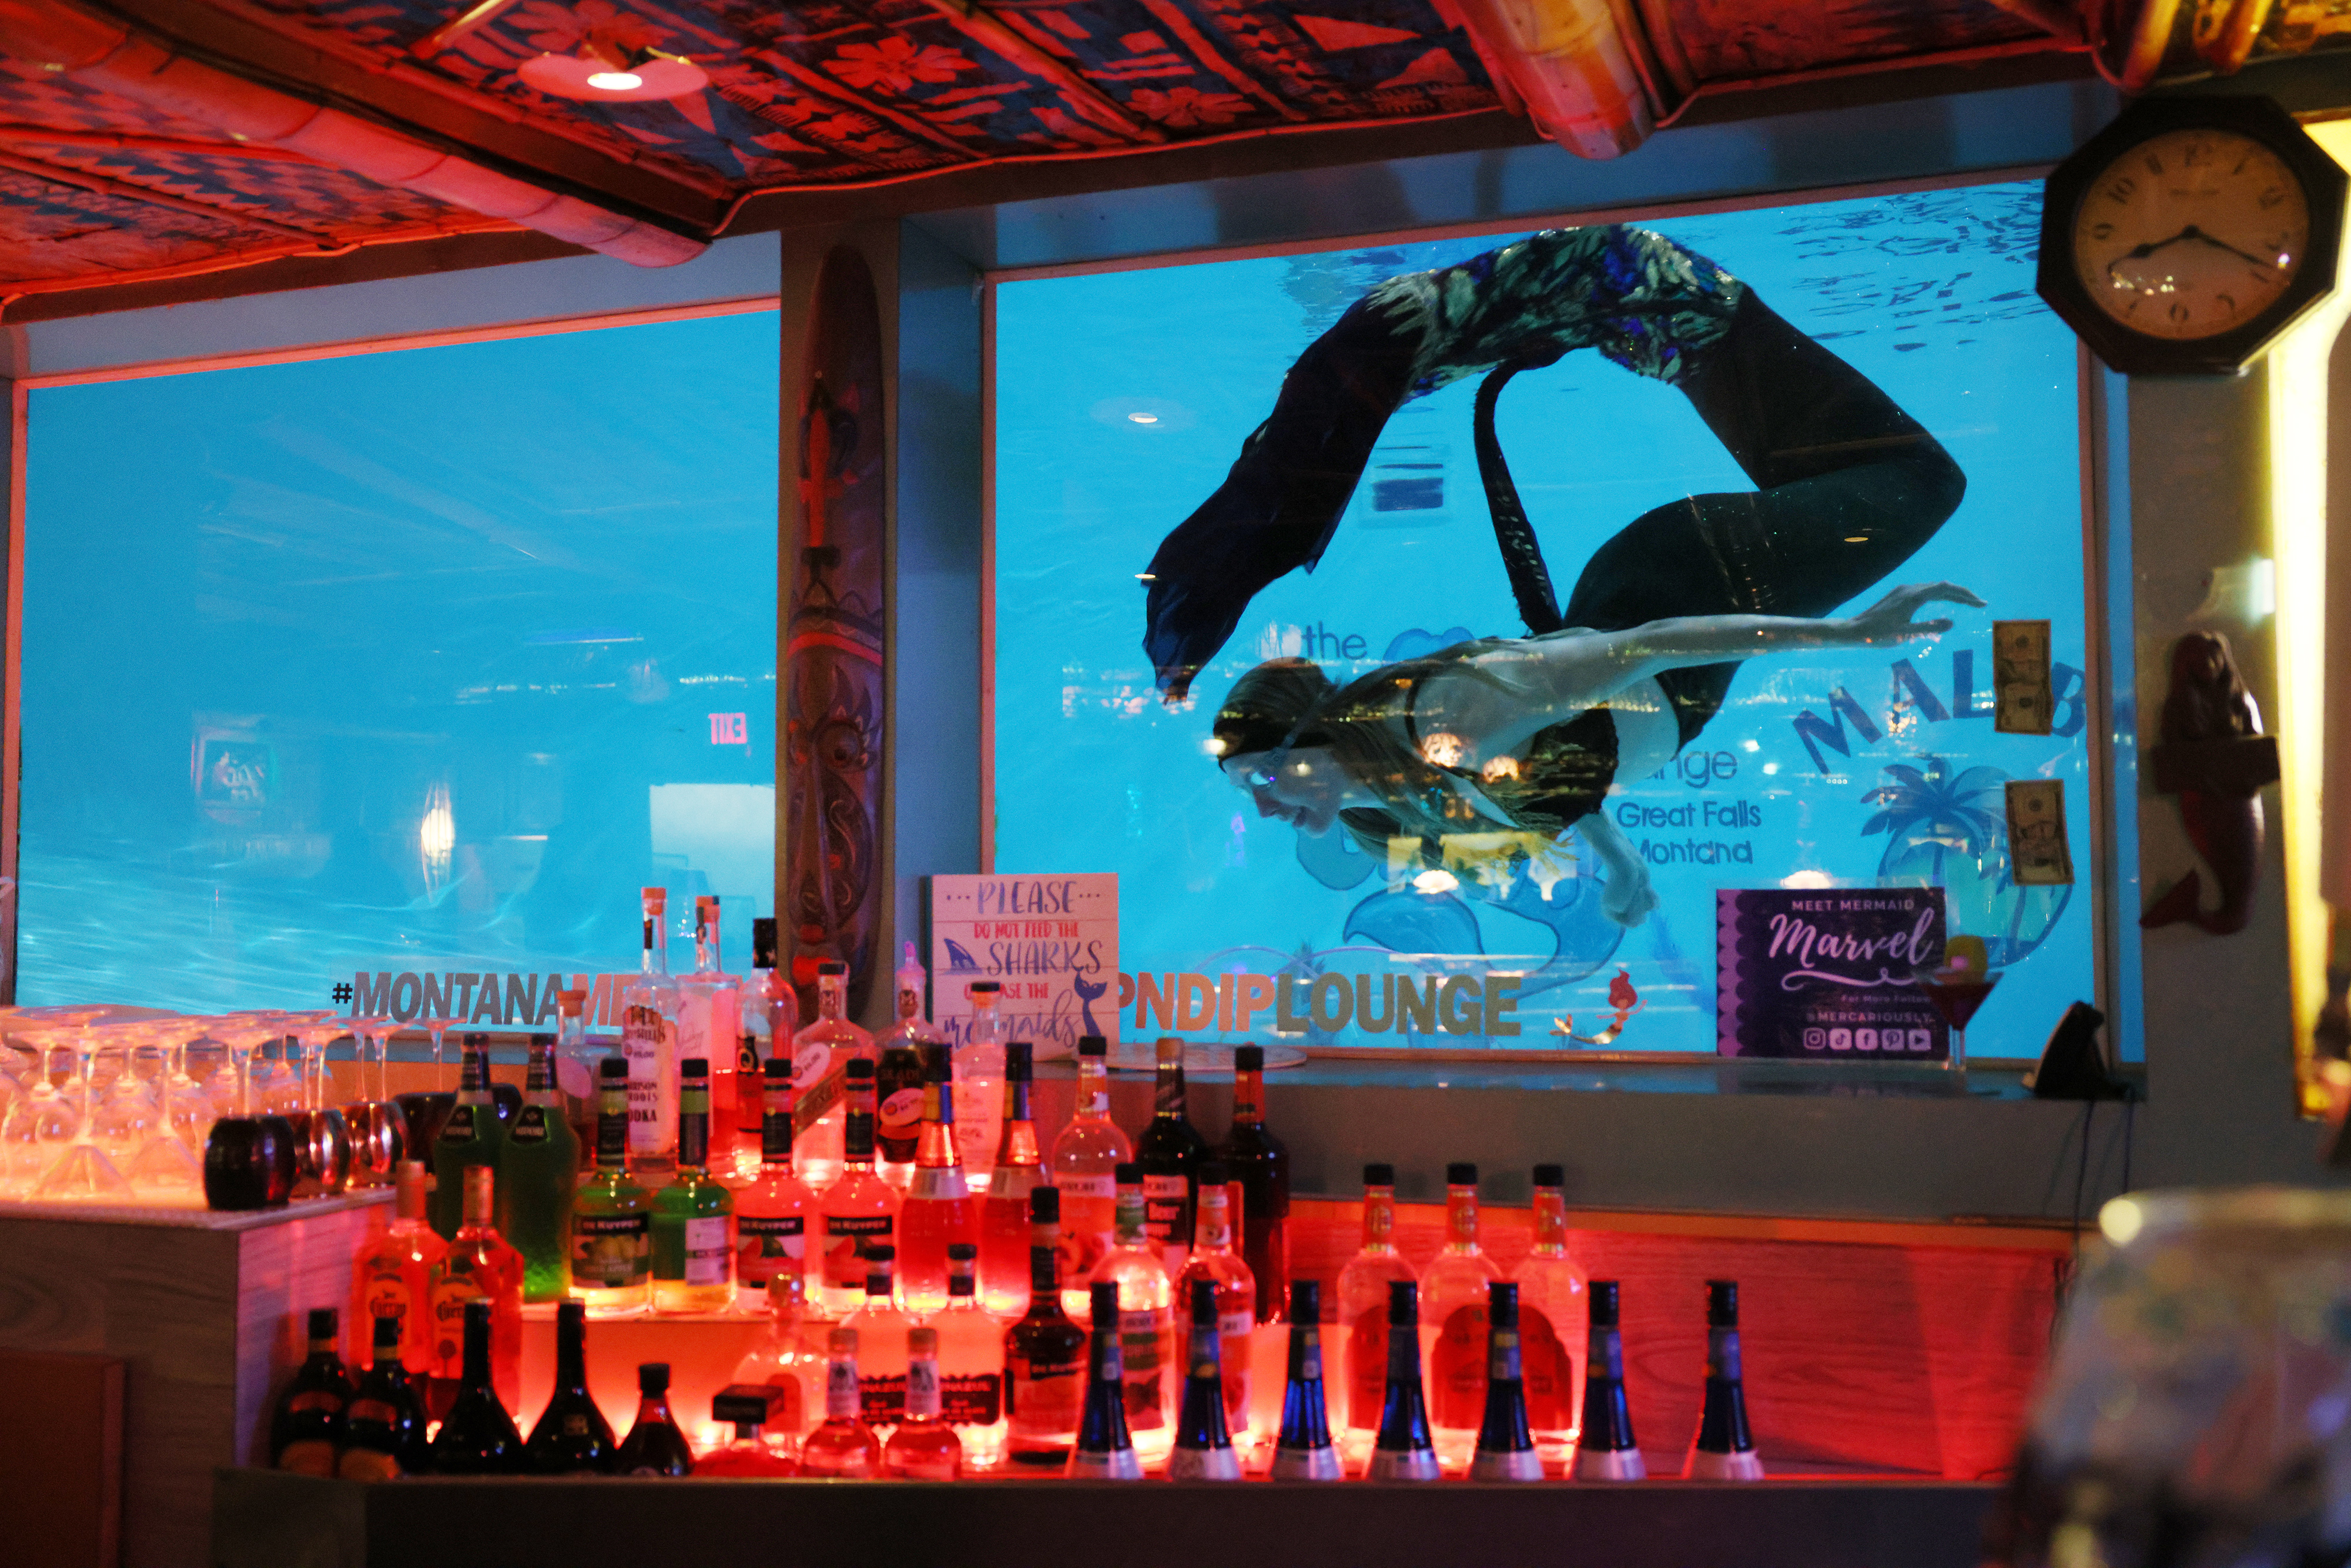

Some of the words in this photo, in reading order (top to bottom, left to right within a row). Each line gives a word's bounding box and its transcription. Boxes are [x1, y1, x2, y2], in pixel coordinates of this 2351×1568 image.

[1301, 621, 1368, 660] the
[1617, 802, 1696, 828] Great
[1703, 800, 1762, 828] Falls
[977, 881, 1077, 914] PLEASE
[1791, 900, 1833, 911] MEET
[1840, 899, 1915, 911] MERMAID
[974, 923, 991, 940] DO
[995, 923, 1019, 939] NOT
[1058, 922, 1079, 938] THE
[1768, 907, 1935, 969] Marvel
[987, 940, 1103, 976] SHARKS
[1027, 982, 1049, 999] THE
